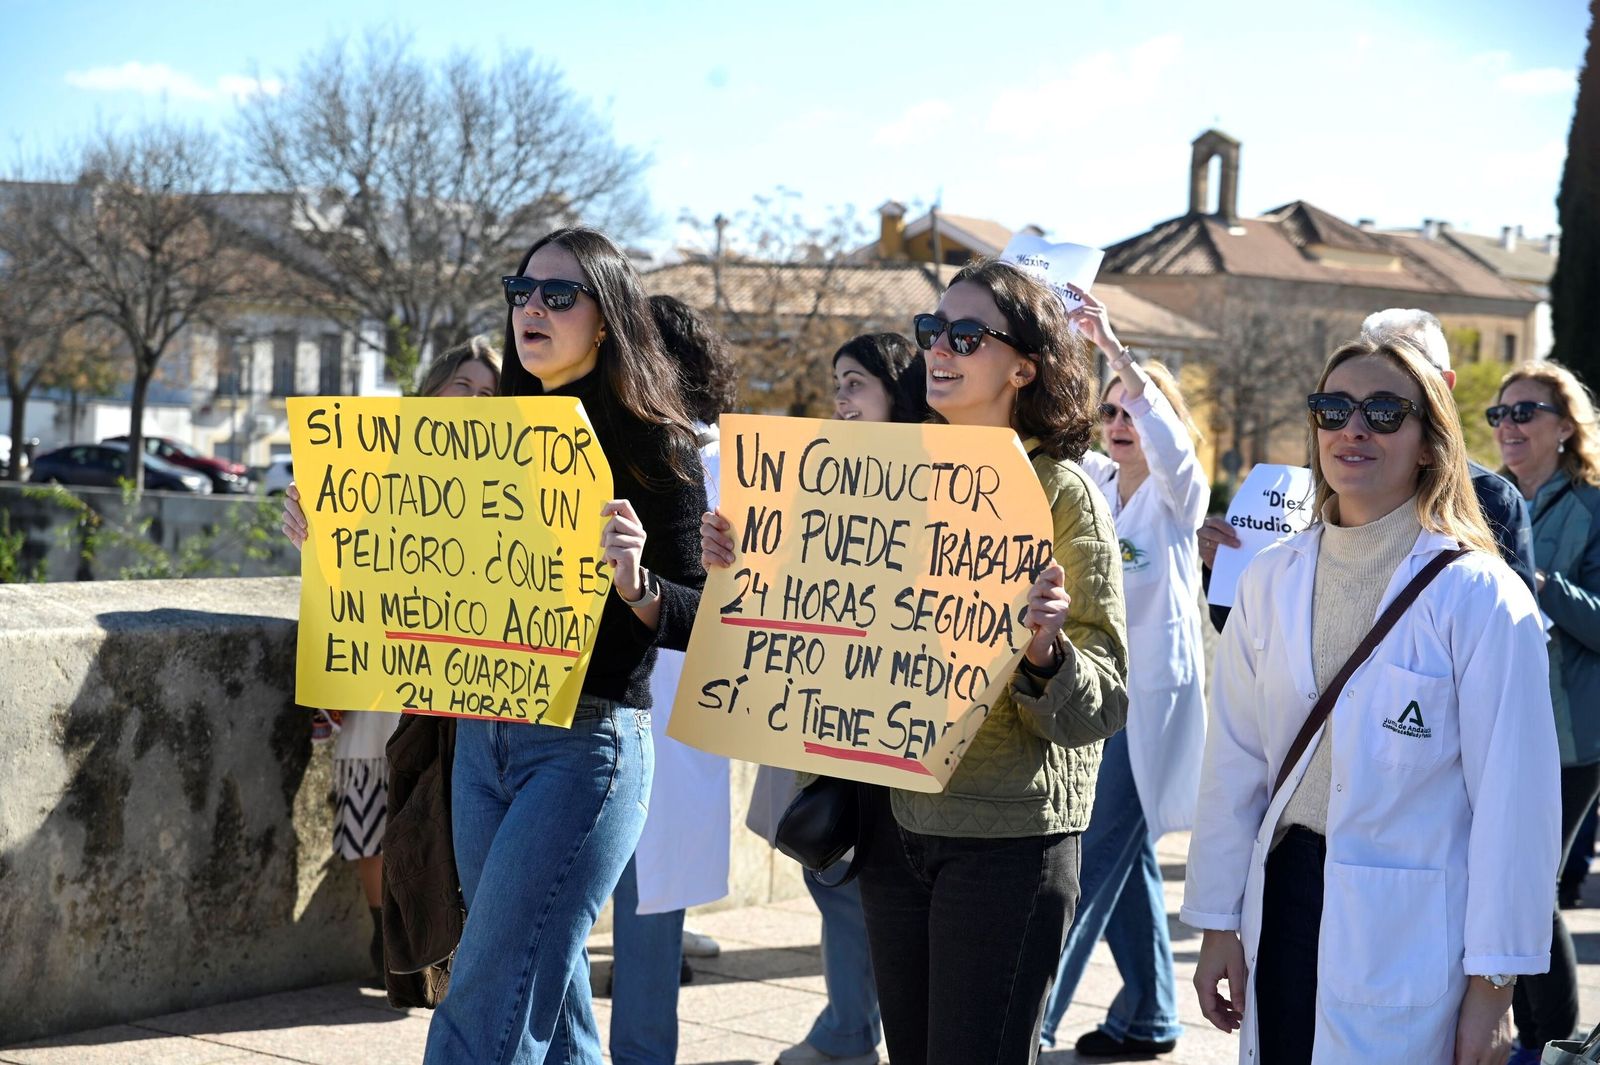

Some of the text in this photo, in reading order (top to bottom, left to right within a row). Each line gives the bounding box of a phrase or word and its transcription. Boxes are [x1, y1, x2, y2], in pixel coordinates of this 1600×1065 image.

[357, 413, 401, 455] UN
[414, 416, 596, 481] CONDUCTOR
[799, 437, 1002, 520] CONDUCTOR
[316, 464, 581, 531] AGOTADO ES UN
[741, 506, 782, 555] NO
[801, 509, 910, 571] PUEDE
[579, 557, 610, 597] ES
[720, 567, 769, 617] 24
[782, 574, 876, 628] HORAS
[329, 586, 364, 623] UN
[381, 586, 487, 636] MÉDICO
[325, 633, 368, 676] EN
[382, 644, 432, 676] UNA
[743, 630, 990, 702] PERO UN MÉDICO
[395, 682, 549, 725] 24 HORAS?
